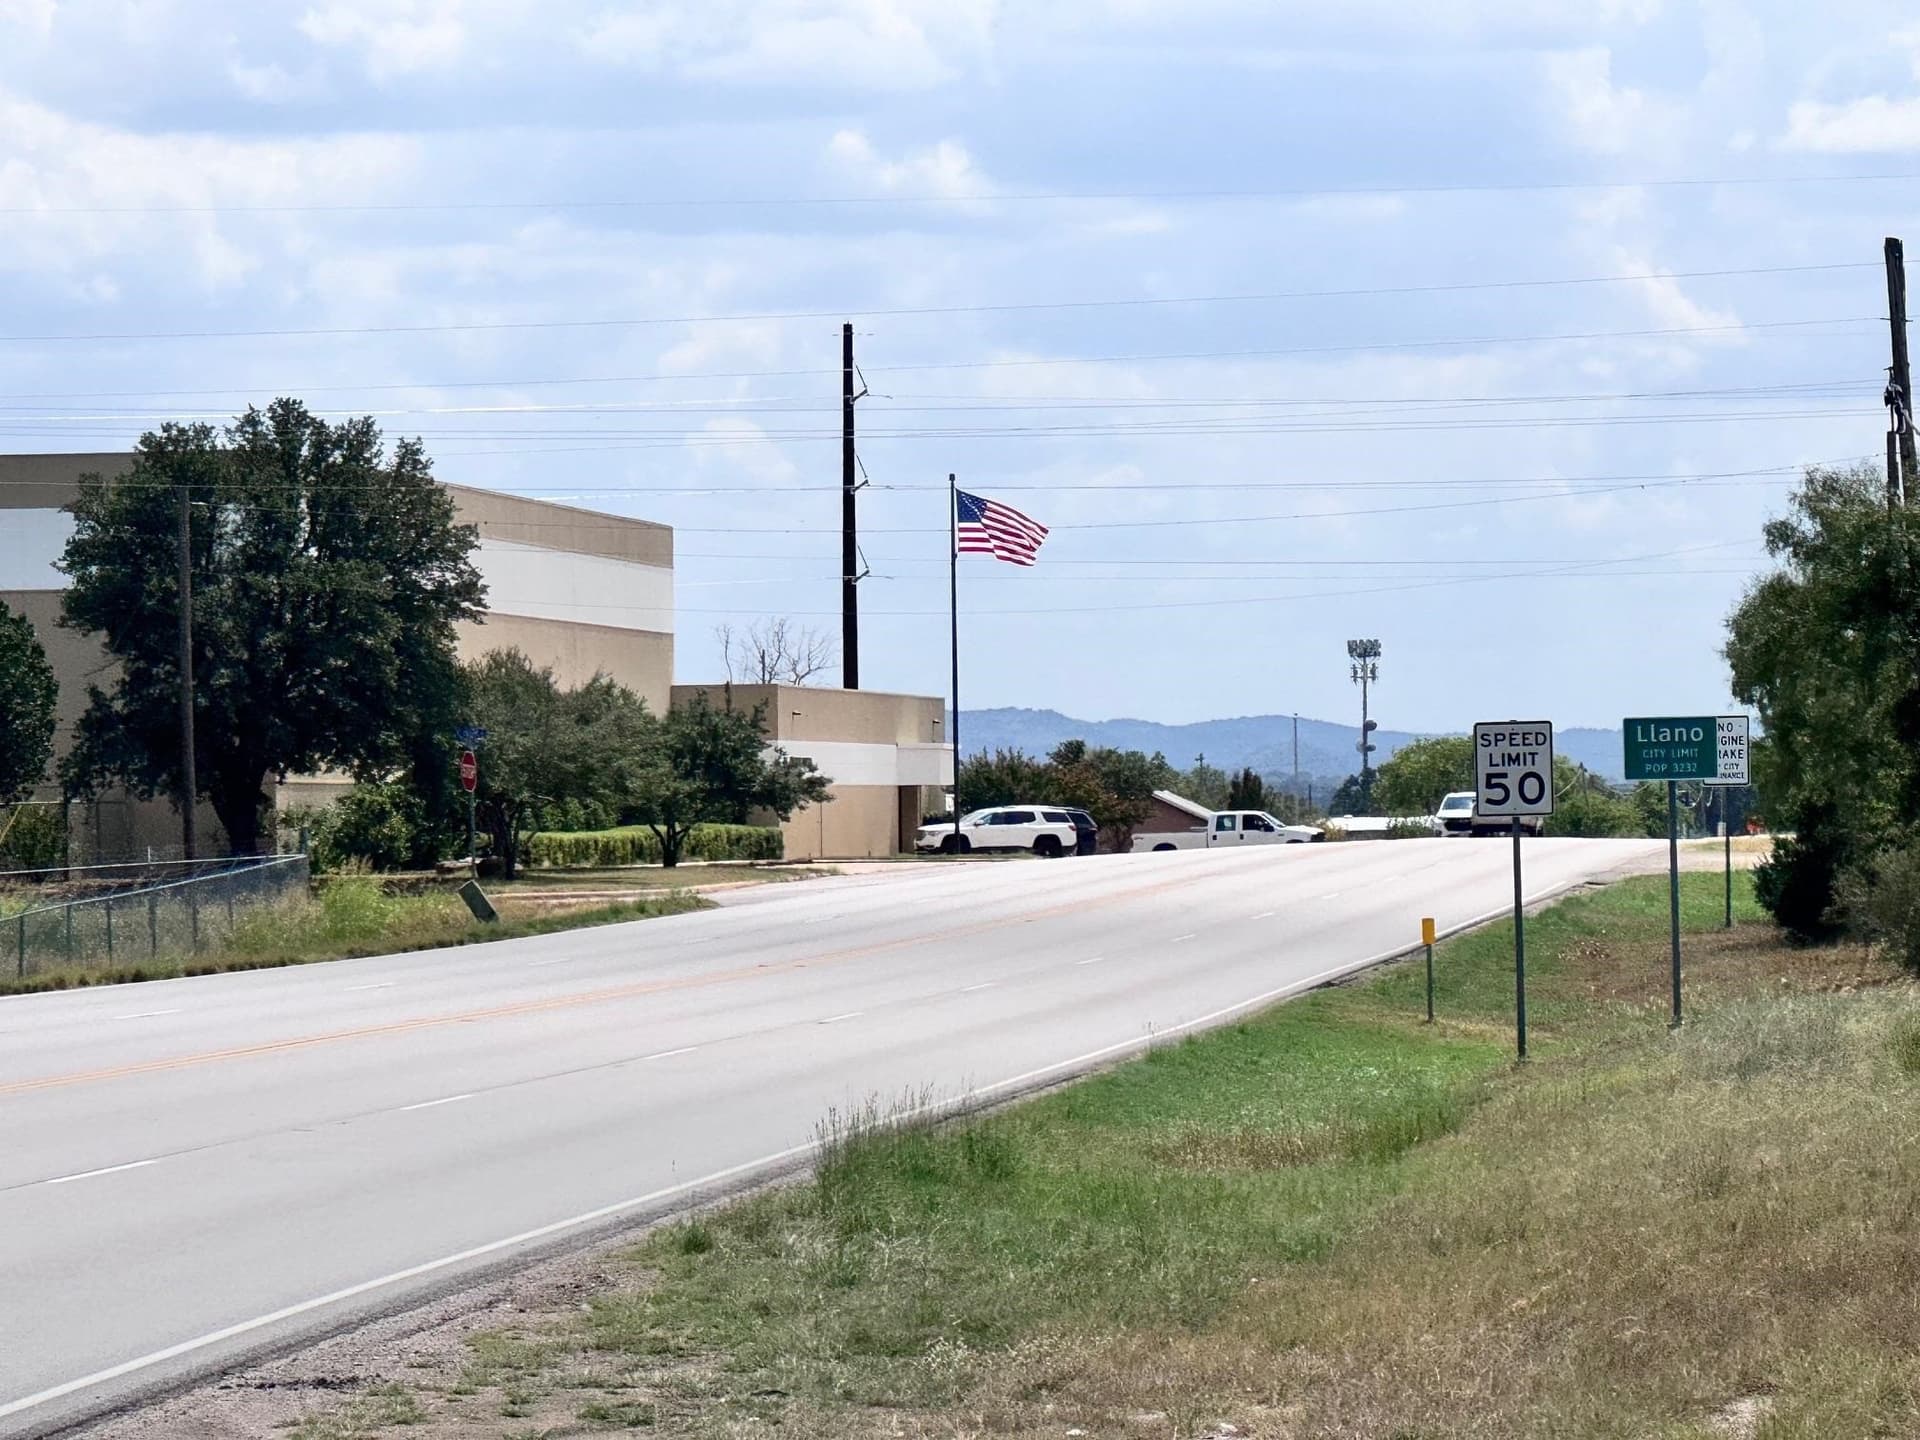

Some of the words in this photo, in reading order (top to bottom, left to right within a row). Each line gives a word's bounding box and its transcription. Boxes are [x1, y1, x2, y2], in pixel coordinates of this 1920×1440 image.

[1637, 723, 1704, 742] Llano
[1718, 722, 1734, 733] NO
[1480, 731, 1548, 748] SPEED
[1718, 735, 1745, 746] GINE
[1642, 748, 1666, 759] CITY
[1671, 748, 1699, 759] LIMIT
[1718, 749, 1744, 759] AKE
[1488, 751, 1540, 768] LIMIT
[1645, 763, 1668, 773] POP
[1672, 762, 1697, 773] 3232
[1723, 762, 1740, 770] CITY
[1484, 771, 1546, 806] 50
